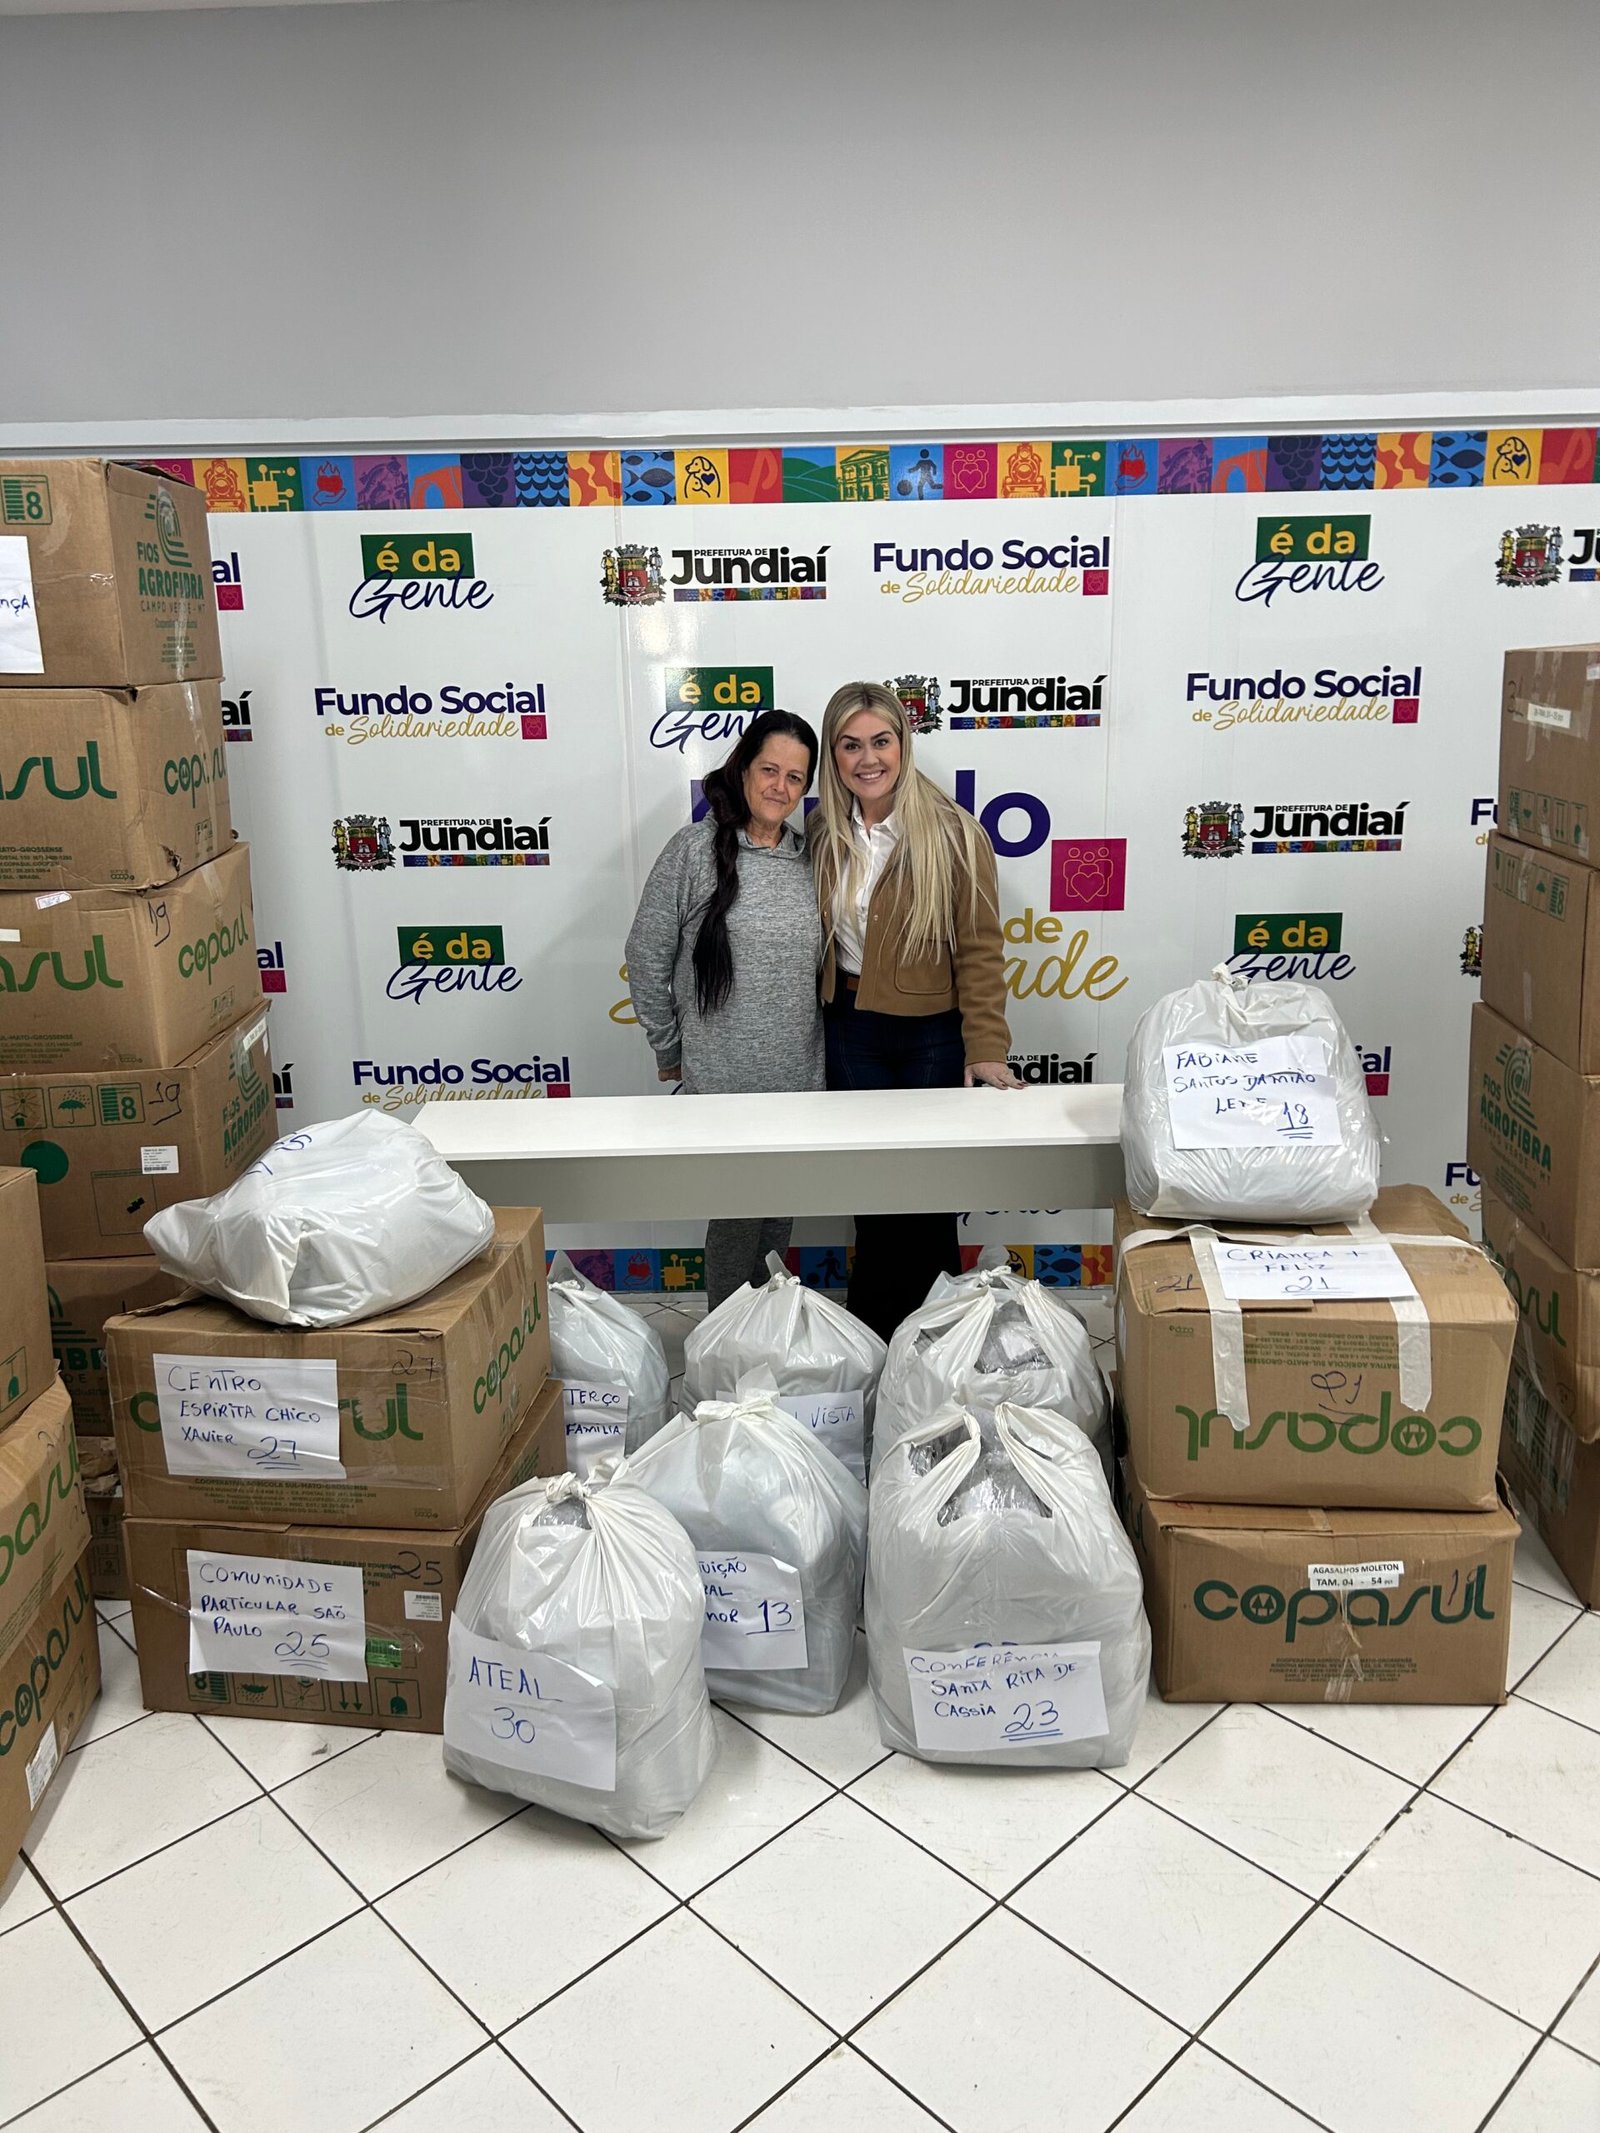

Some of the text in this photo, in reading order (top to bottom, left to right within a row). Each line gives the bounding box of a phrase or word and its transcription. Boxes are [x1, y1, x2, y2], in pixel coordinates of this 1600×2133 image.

[137, 541, 160, 564] FIOS
[694, 548, 768, 557] PREFEITURA DE
[874, 535, 1110, 572] Fundo Social
[1270, 522, 1356, 555] é da
[376, 541, 461, 572] é da
[670, 545, 831, 585] Jundiaí
[349, 564, 494, 624] Gente
[881, 568, 1080, 603] de Solidariedade
[1235, 549, 1385, 607] Gente
[678, 673, 761, 705] é da
[947, 674, 1108, 714] Jundiaí
[972, 677, 1045, 686] PREFEITURA DE
[1186, 665, 1422, 701] Fundo Social
[314, 682, 546, 716] Fundo Social
[1192, 696, 1390, 731] de Solidariedade
[325, 713, 519, 745] de Solidariedade
[421, 818, 491, 827] PREFEITURA DE
[1250, 801, 1411, 838] Jundiaí
[1275, 803, 1348, 813] PREFEITURA DE
[399, 817, 552, 851] Jundiaí
[1003, 908, 1063, 944] de
[1247, 920, 1329, 949] é da
[178, 905, 249, 985] copasul
[412, 932, 492, 960] é da
[386, 954, 523, 1005] Gente
[352, 1055, 570, 1085] Fundo Social
[362, 1092, 380, 1104] de
[1483, 1073, 1501, 1102] FIOS
[223, 1083, 270, 1155] AGROFIBRA
[1480, 1094, 1552, 1172] AGROFIBRA
[1450, 1193, 1468, 1204] de
[1284, 1276, 1341, 1293] 21
[473, 1280, 542, 1415] copasul
[567, 1388, 621, 1405] TERÇO
[811, 1406, 856, 1428] VISTA
[1175, 1391, 1483, 1461] copasul
[247, 1436, 298, 1460] 27
[393, 1550, 443, 1586] 25
[1313, 1563, 1399, 1574] AGASALHOS MOLETON
[1316, 1578, 1341, 1587] TAM.
[1342, 1578, 1353, 1586] 04
[1371, 1577, 1382, 1585] 54
[757, 1599, 793, 1633] 13
[1193, 1564, 1495, 1643] copasul
[213, 1616, 331, 1658] PAULO 25
[468, 1656, 563, 1702] ATEAL
[490, 1706, 536, 1744] 30
[1004, 1700, 1060, 1734] 23
